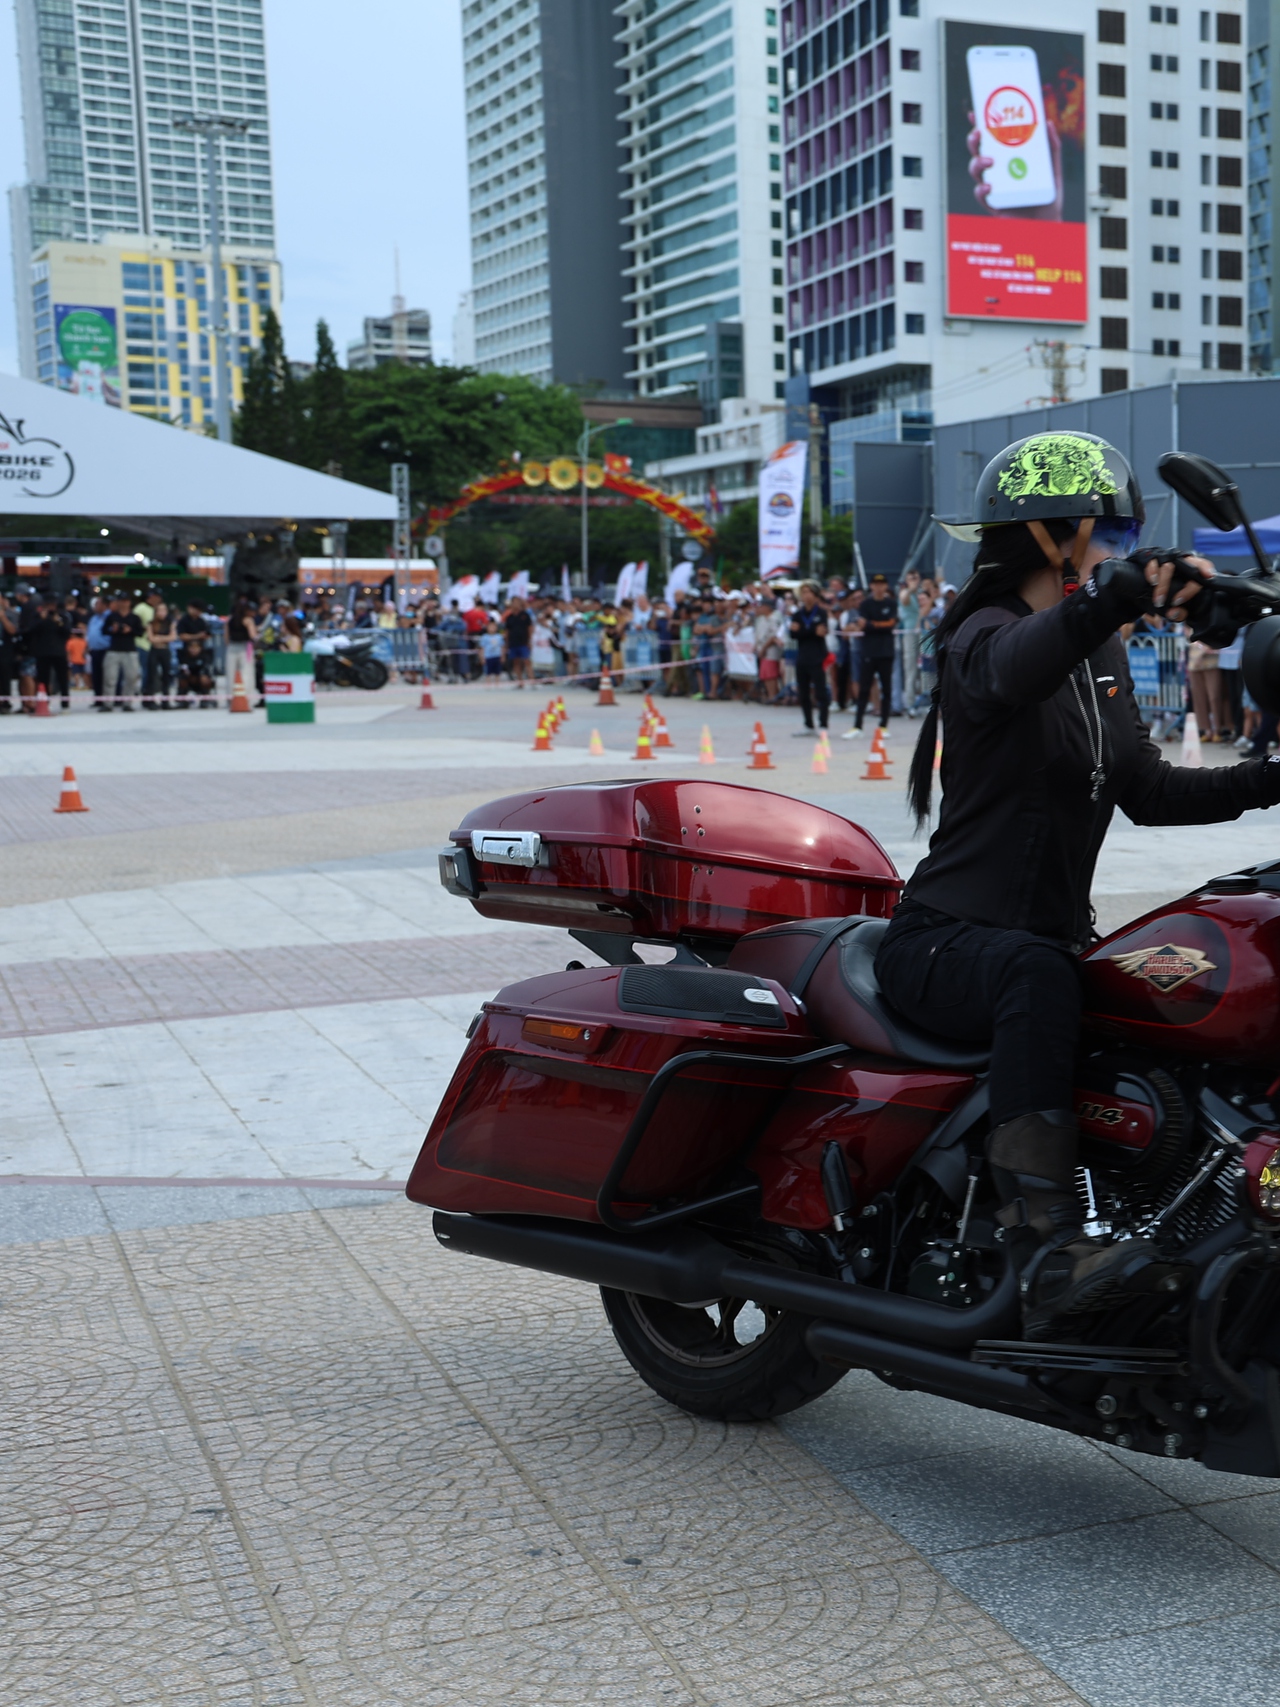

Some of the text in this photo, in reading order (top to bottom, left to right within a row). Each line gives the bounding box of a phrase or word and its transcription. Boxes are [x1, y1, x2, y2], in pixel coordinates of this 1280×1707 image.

[1035, 268, 1062, 283] HELP
[1063, 270, 1083, 284] 114
[1143, 965, 1193, 976] DAVIDSON
[1079, 1101, 1125, 1125] 114
